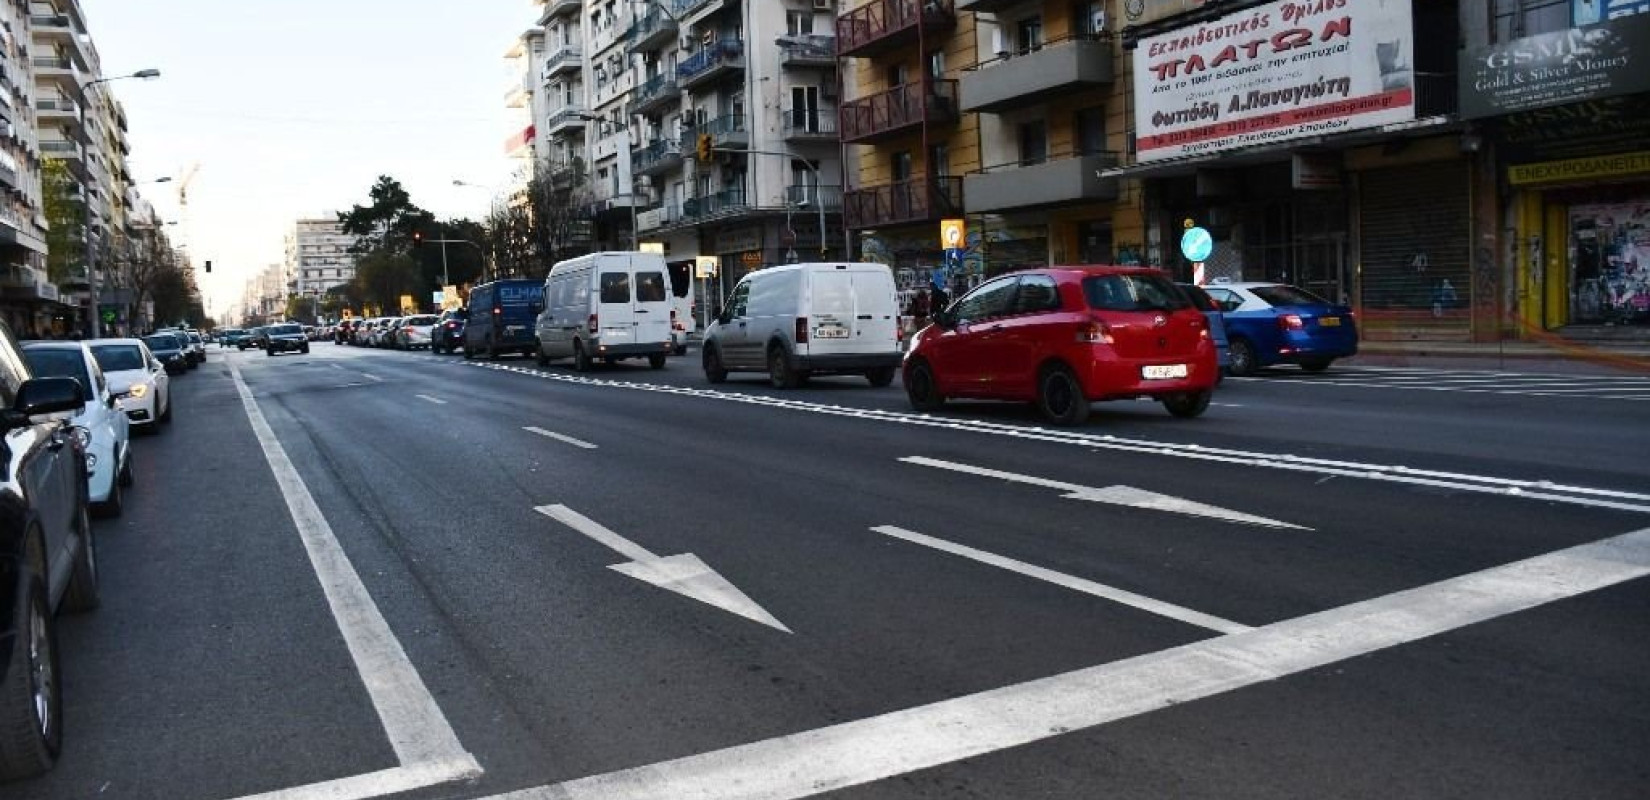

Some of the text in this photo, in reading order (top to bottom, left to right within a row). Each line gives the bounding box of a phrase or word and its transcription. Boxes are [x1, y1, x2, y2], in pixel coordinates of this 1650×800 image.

[1148, 12, 1270, 58] Εκπαιδευτικός
[1149, 16, 1352, 81] ΠΛΑΤΩΝ
[1475, 69, 1509, 92] Gold
[1513, 70, 1525, 84] &
[1530, 65, 1569, 81] Silver
[1575, 55, 1628, 71] Money
